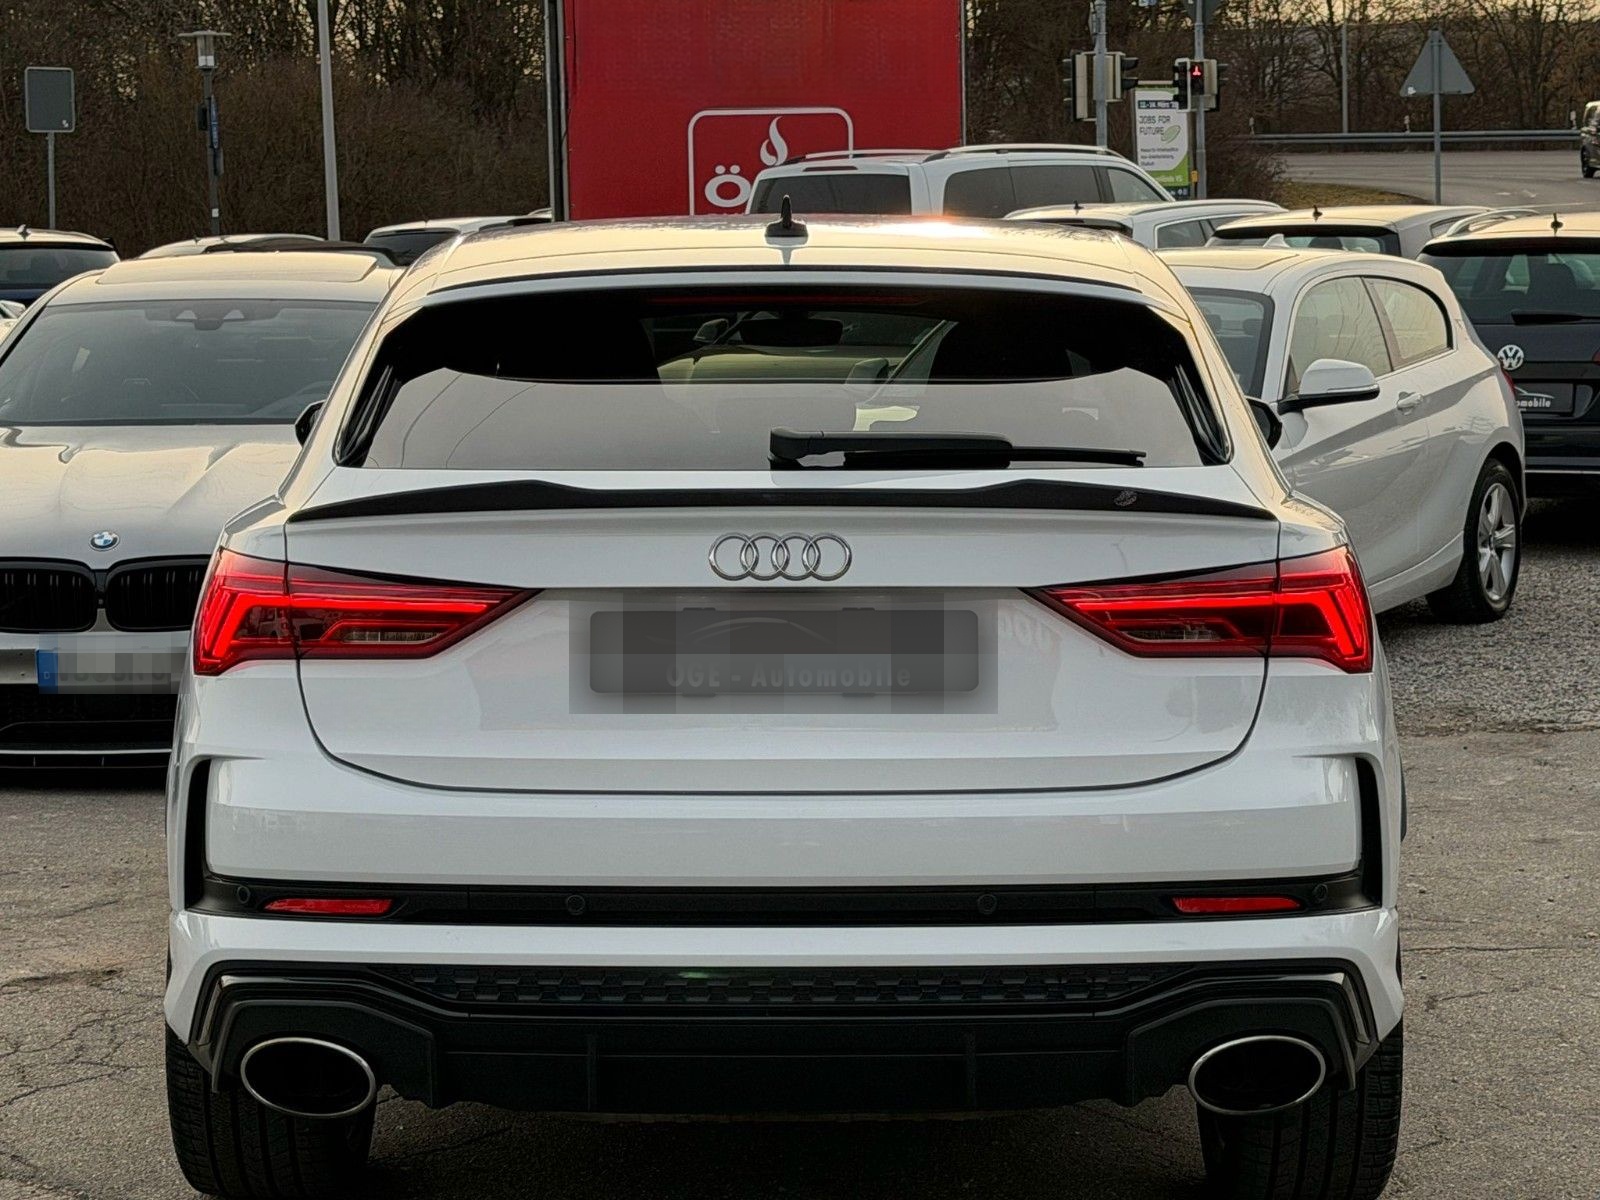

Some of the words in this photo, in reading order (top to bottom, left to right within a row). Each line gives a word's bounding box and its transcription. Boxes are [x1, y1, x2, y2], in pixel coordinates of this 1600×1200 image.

[1139, 115, 1157, 124] JOBS
[1158, 115, 1171, 124] FOR
[1139, 126, 1165, 135] FUTURE
[751, 660, 911, 687] Automobile
